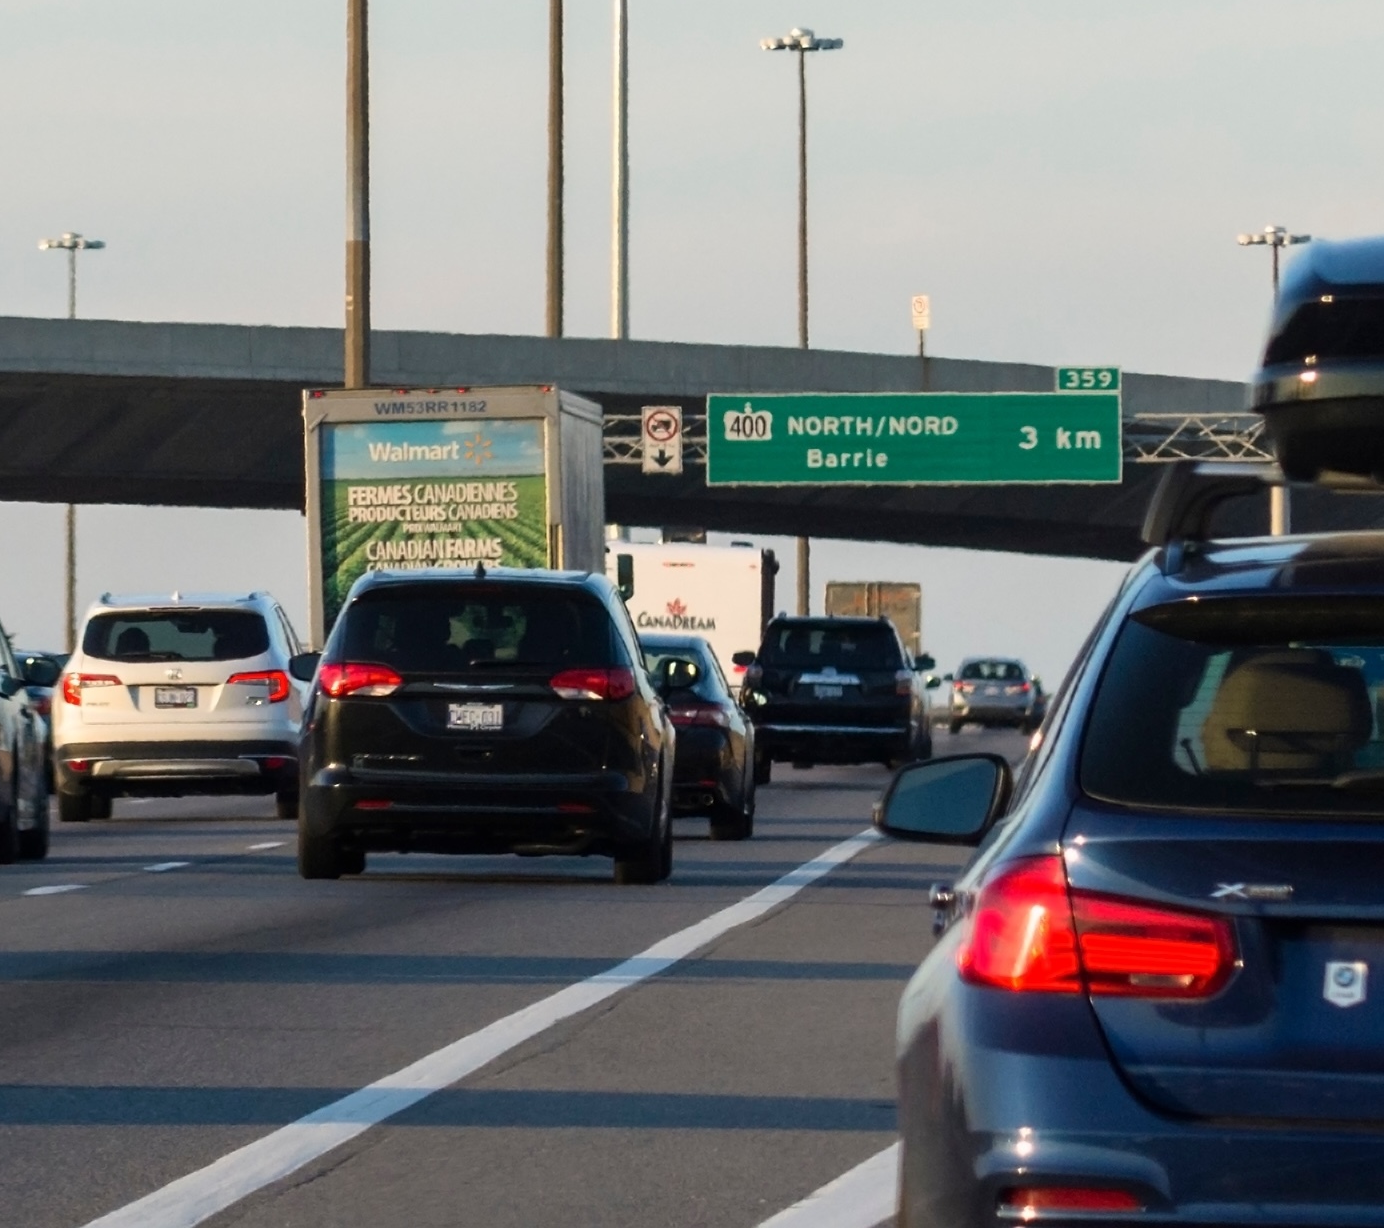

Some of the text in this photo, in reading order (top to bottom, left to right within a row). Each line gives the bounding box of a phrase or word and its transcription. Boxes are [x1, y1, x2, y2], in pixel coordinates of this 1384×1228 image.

[1065, 370, 1113, 389] 359
[374, 400, 488, 415] WM53RR1182
[729, 414, 767, 439] 400
[787, 415, 959, 437] NORTH/NORD
[1018, 425, 1102, 450] 3 km
[368, 440, 461, 462] Walmart
[806, 448, 889, 468] Barrie
[347, 482, 518, 506] FERMES CANADIENNES
[348, 503, 519, 522] PRODUCTEURS CANADIENS
[366, 537, 503, 561] CANADIAN FARMS
